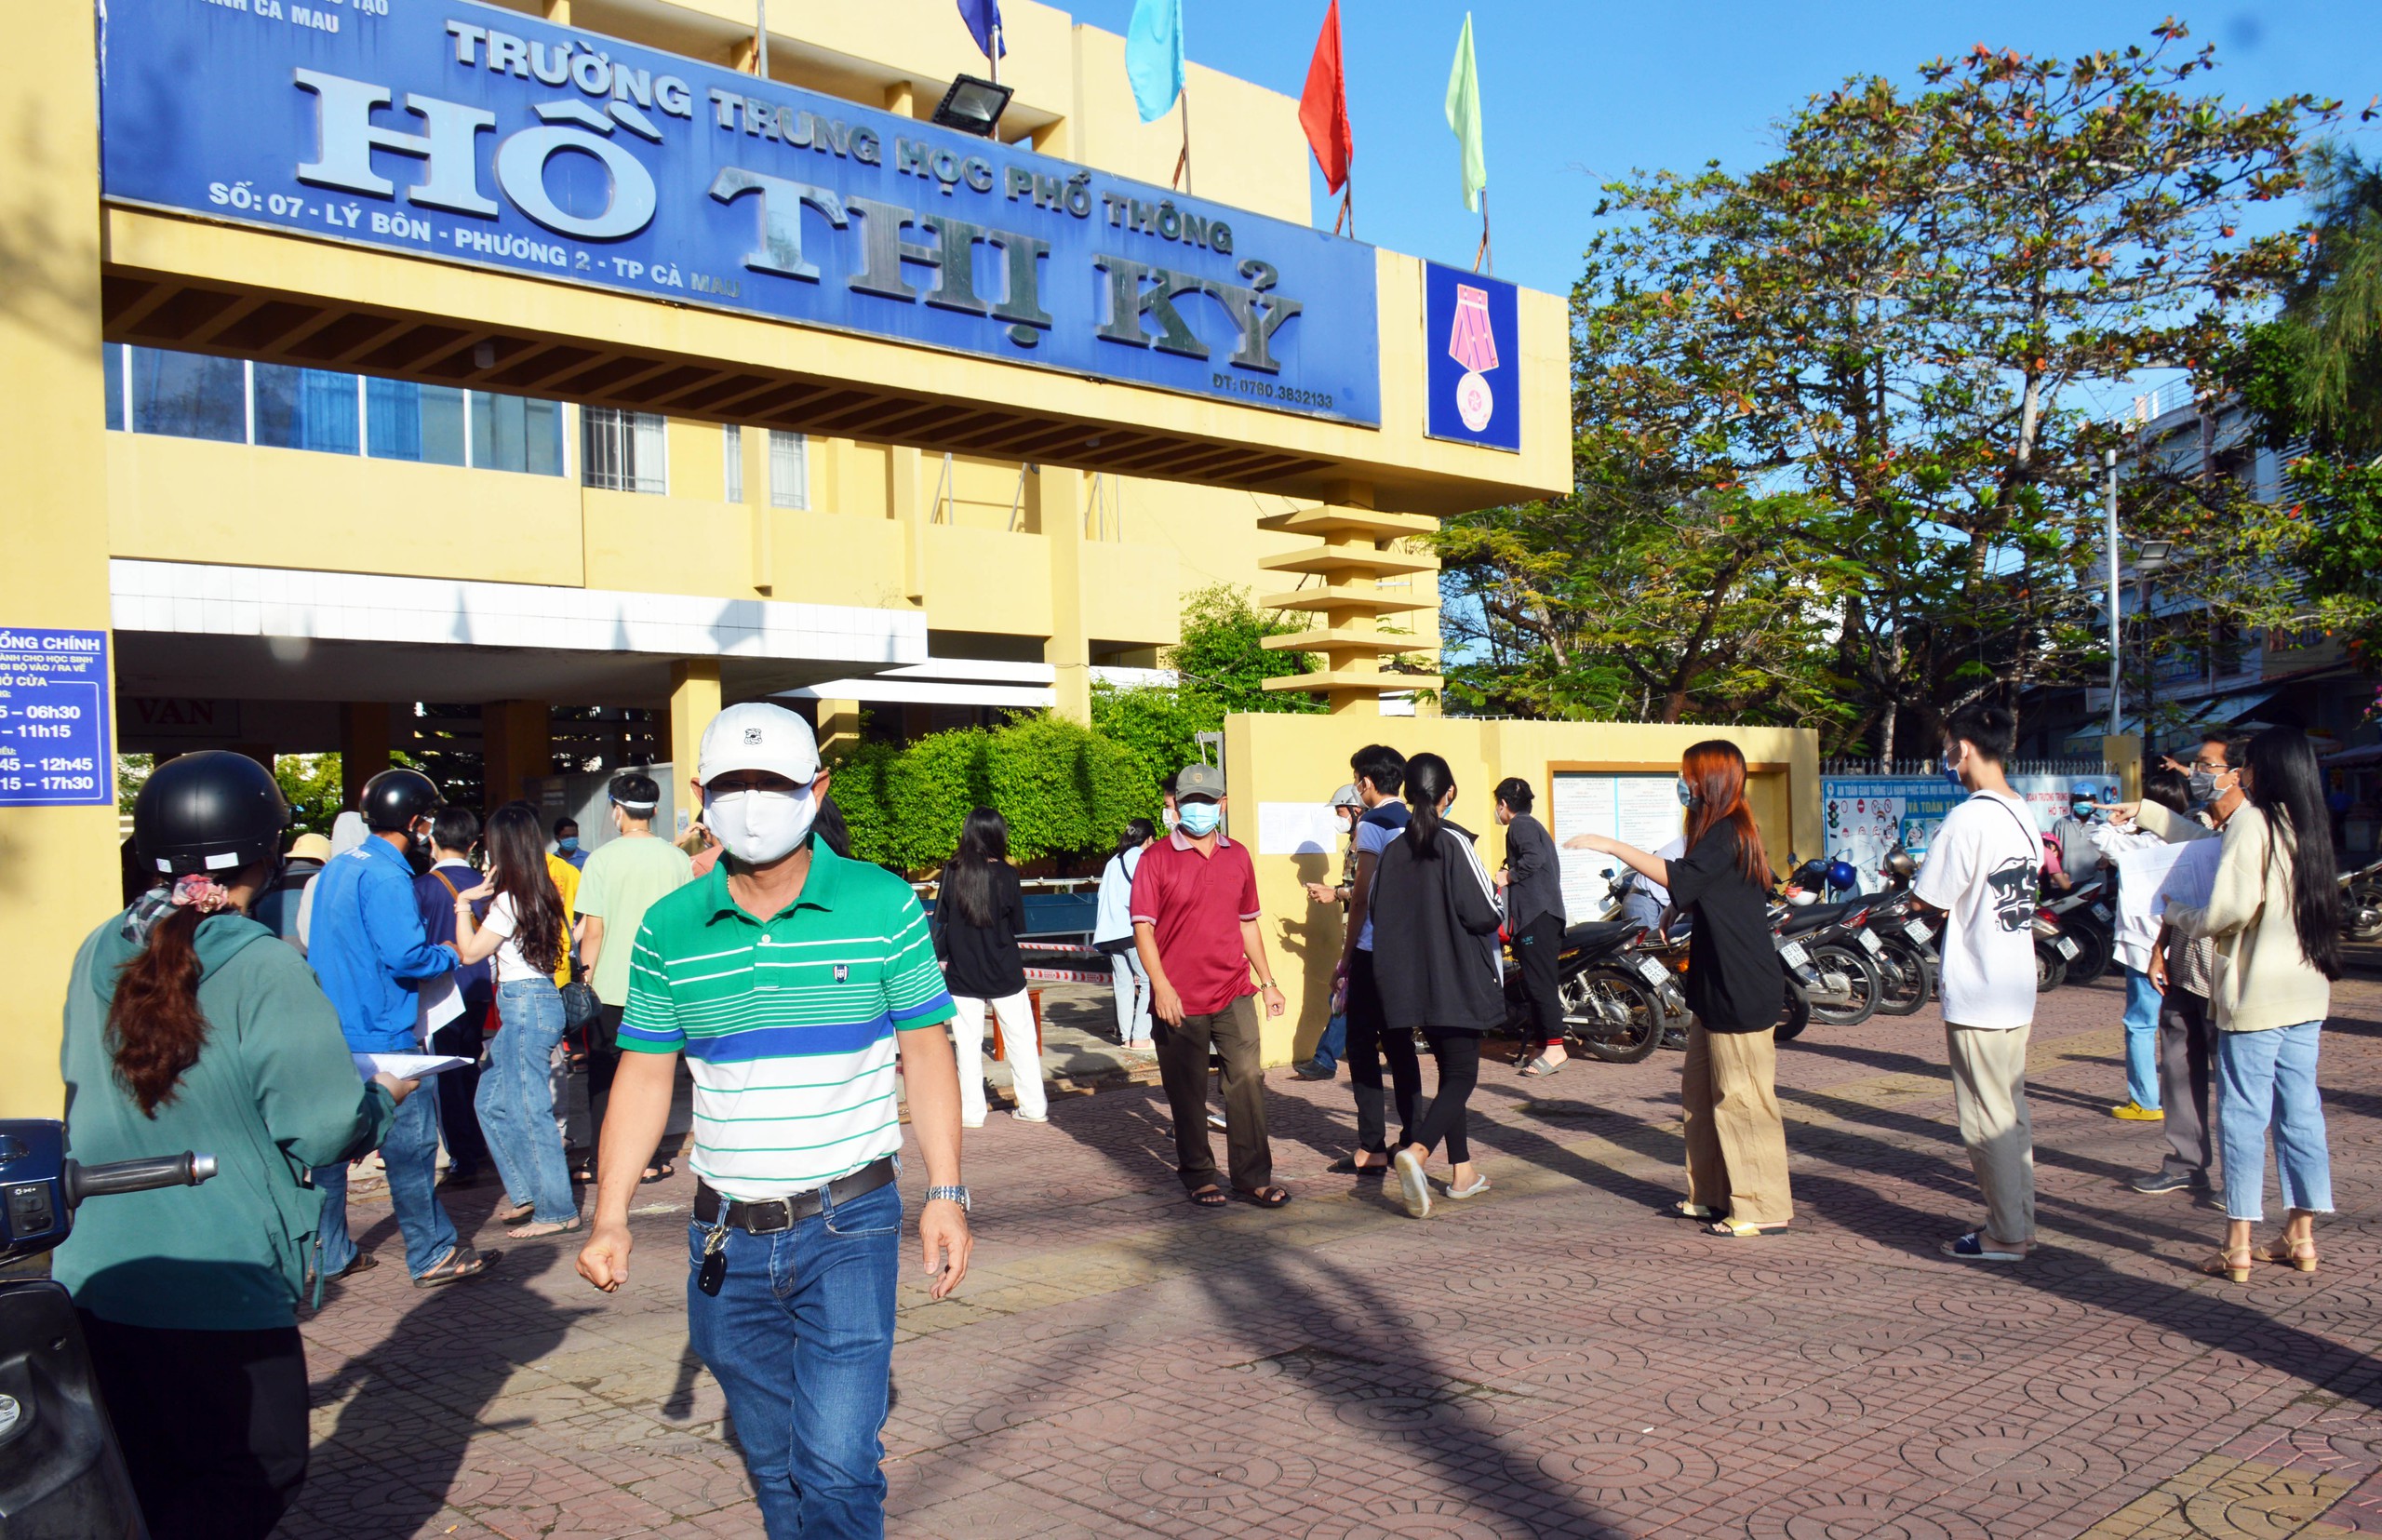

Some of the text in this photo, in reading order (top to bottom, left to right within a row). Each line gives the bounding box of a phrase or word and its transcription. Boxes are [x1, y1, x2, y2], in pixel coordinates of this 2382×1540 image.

[291, 6, 340, 33] MAU
[446, 20, 1233, 255] TRƯỜNG TRUNG HỌC PHỔ THÔNG
[293, 66, 1304, 374] HỒ THỊ KỶ
[208, 180, 262, 212] SỐ:
[268, 194, 303, 218] 07
[326, 202, 362, 229] LÝ
[372, 211, 431, 242] BÔN
[454, 228, 568, 267] PHƯƠNG
[575, 250, 591, 271] 2
[612, 257, 644, 280] TP
[650, 262, 684, 288] CÀ
[690, 272, 742, 299] MAU
[1213, 373, 1333, 409] ĐT: 0780.3832133
[42, 635, 100, 651] CHÍNH
[21, 654, 45, 663] CHO
[46, 655, 69, 663] HỌC
[12, 662, 28, 672] BỘ
[29, 662, 50, 672] VÀO
[16, 673, 47, 687] CỬA
[26, 705, 81, 719] 06h30
[18, 724, 72, 738] 11h15
[0, 757, 21, 771] 45
[40, 757, 94, 771] 12h45
[0, 777, 21, 790] 15
[40, 776, 94, 790] 17h30
